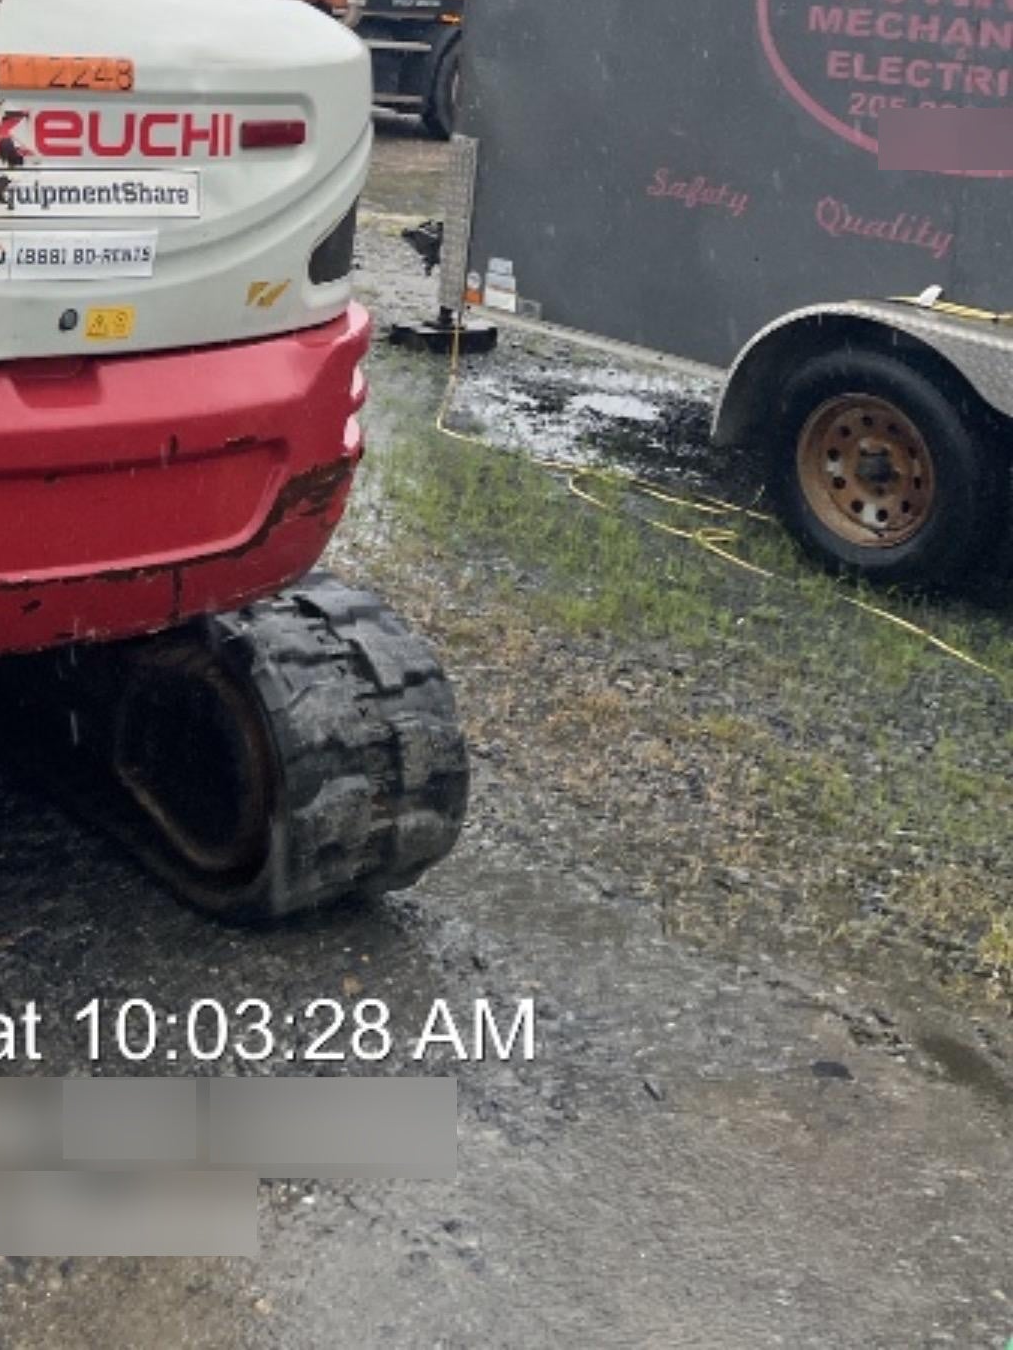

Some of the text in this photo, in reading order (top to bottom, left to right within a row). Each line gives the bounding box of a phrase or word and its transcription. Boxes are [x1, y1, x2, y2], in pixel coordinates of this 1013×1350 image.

[808, 6, 1013, 49] MECHAN
[826, 50, 1010, 97] ELECTRI
[816, 195, 955, 259] Quality
